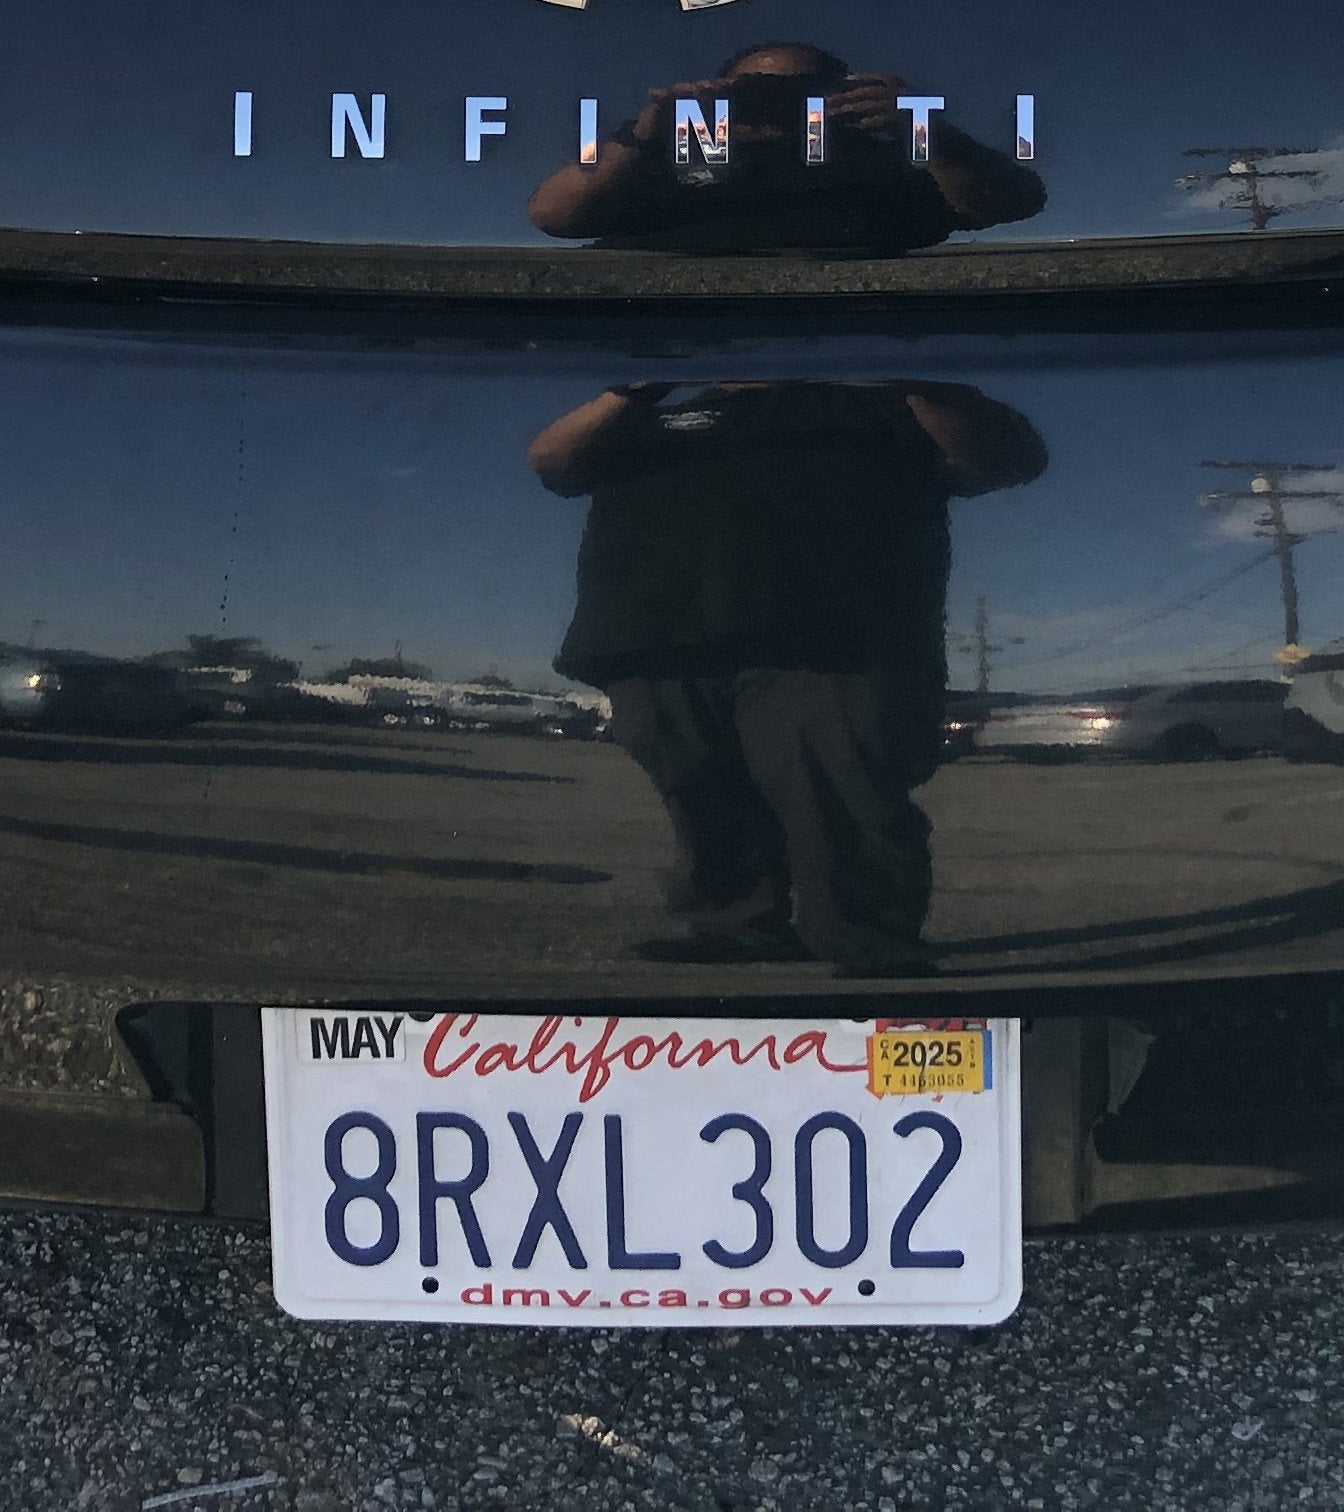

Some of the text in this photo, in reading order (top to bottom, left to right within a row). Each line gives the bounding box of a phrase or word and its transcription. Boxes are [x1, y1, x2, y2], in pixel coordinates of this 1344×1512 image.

[232, 91, 1035, 166] INFINITI
[310, 1016, 404, 1060] MAY
[422, 1012, 869, 1103] California
[893, 1040, 962, 1067] 2025
[323, 1109, 965, 1270] 8RXL302
[460, 1283, 834, 1310] dmv.ca.gov
